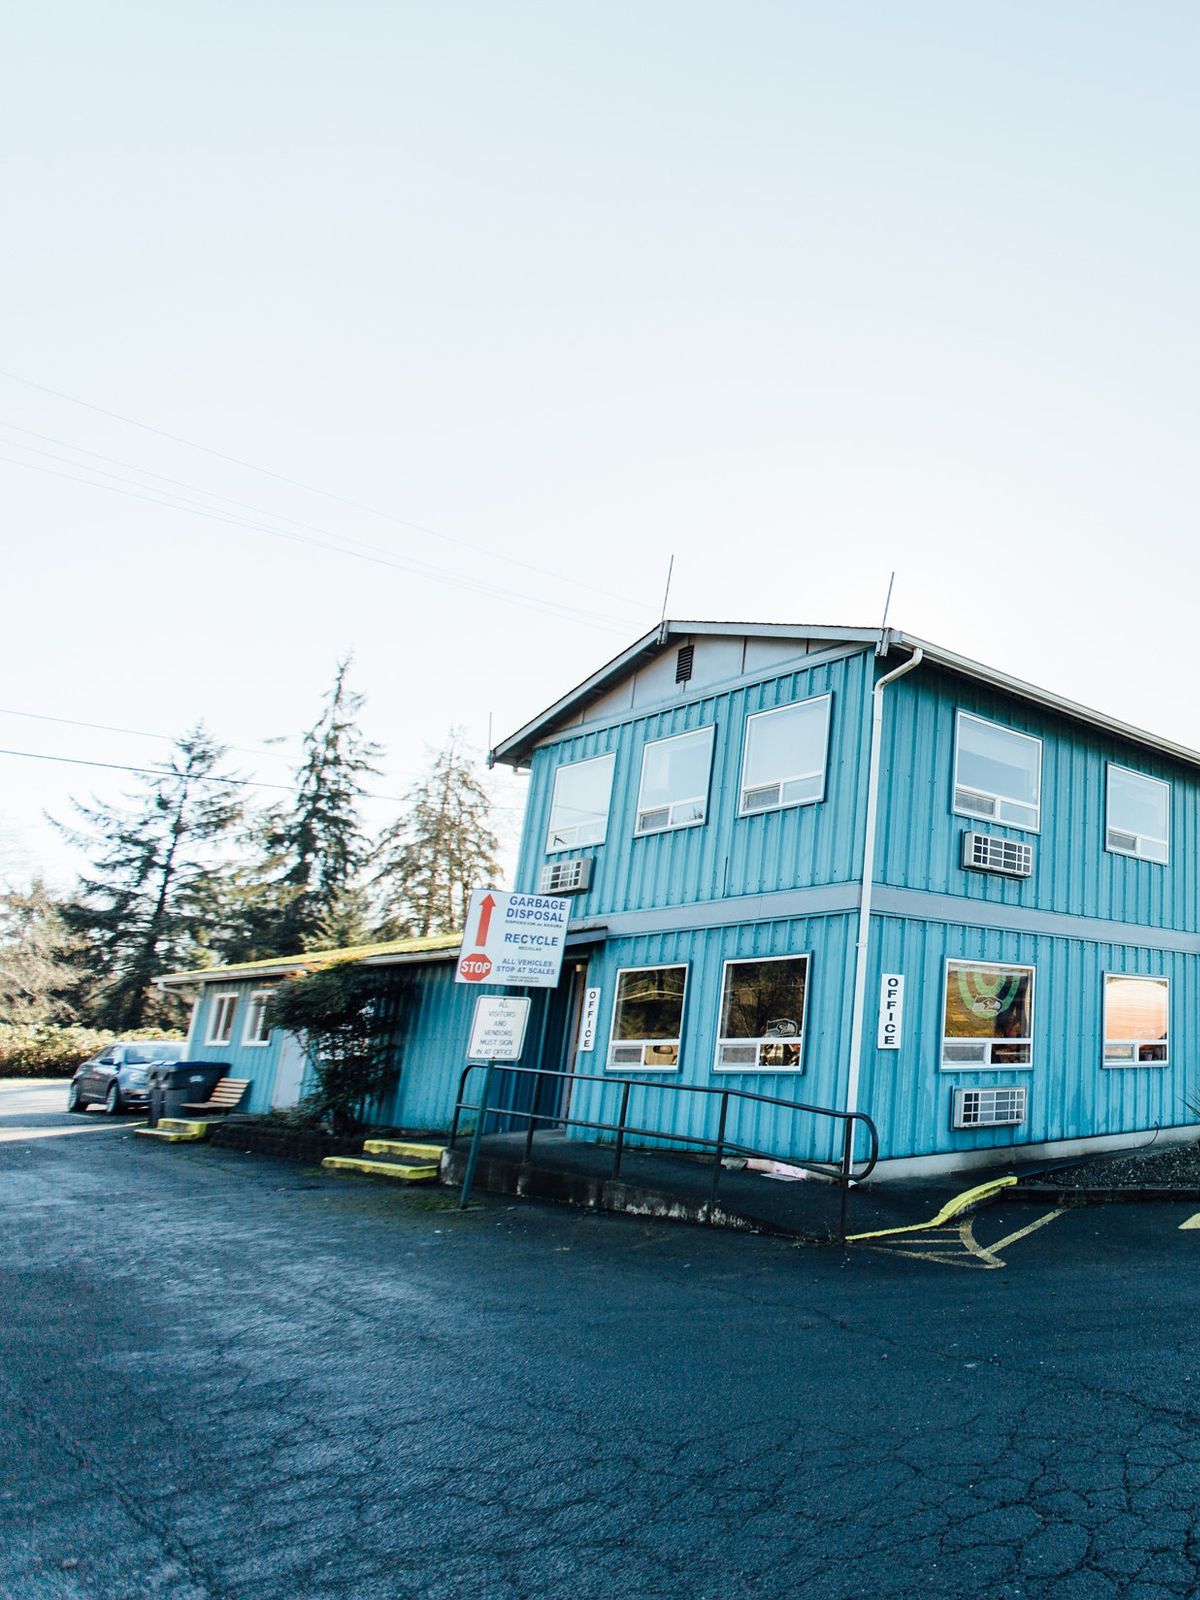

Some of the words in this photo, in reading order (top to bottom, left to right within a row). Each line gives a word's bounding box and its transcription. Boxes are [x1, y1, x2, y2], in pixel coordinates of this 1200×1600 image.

[510, 896, 566, 911] GARBAGE
[506, 908, 564, 923] DISPOSAL
[505, 933, 559, 946] RECYCLE
[461, 961, 491, 973] STOP
[518, 959, 552, 967] VEHICLES
[528, 967, 555, 975] SCALES
[884, 978, 898, 1044] OFFICE
[584, 991, 597, 1047] OFFICE
